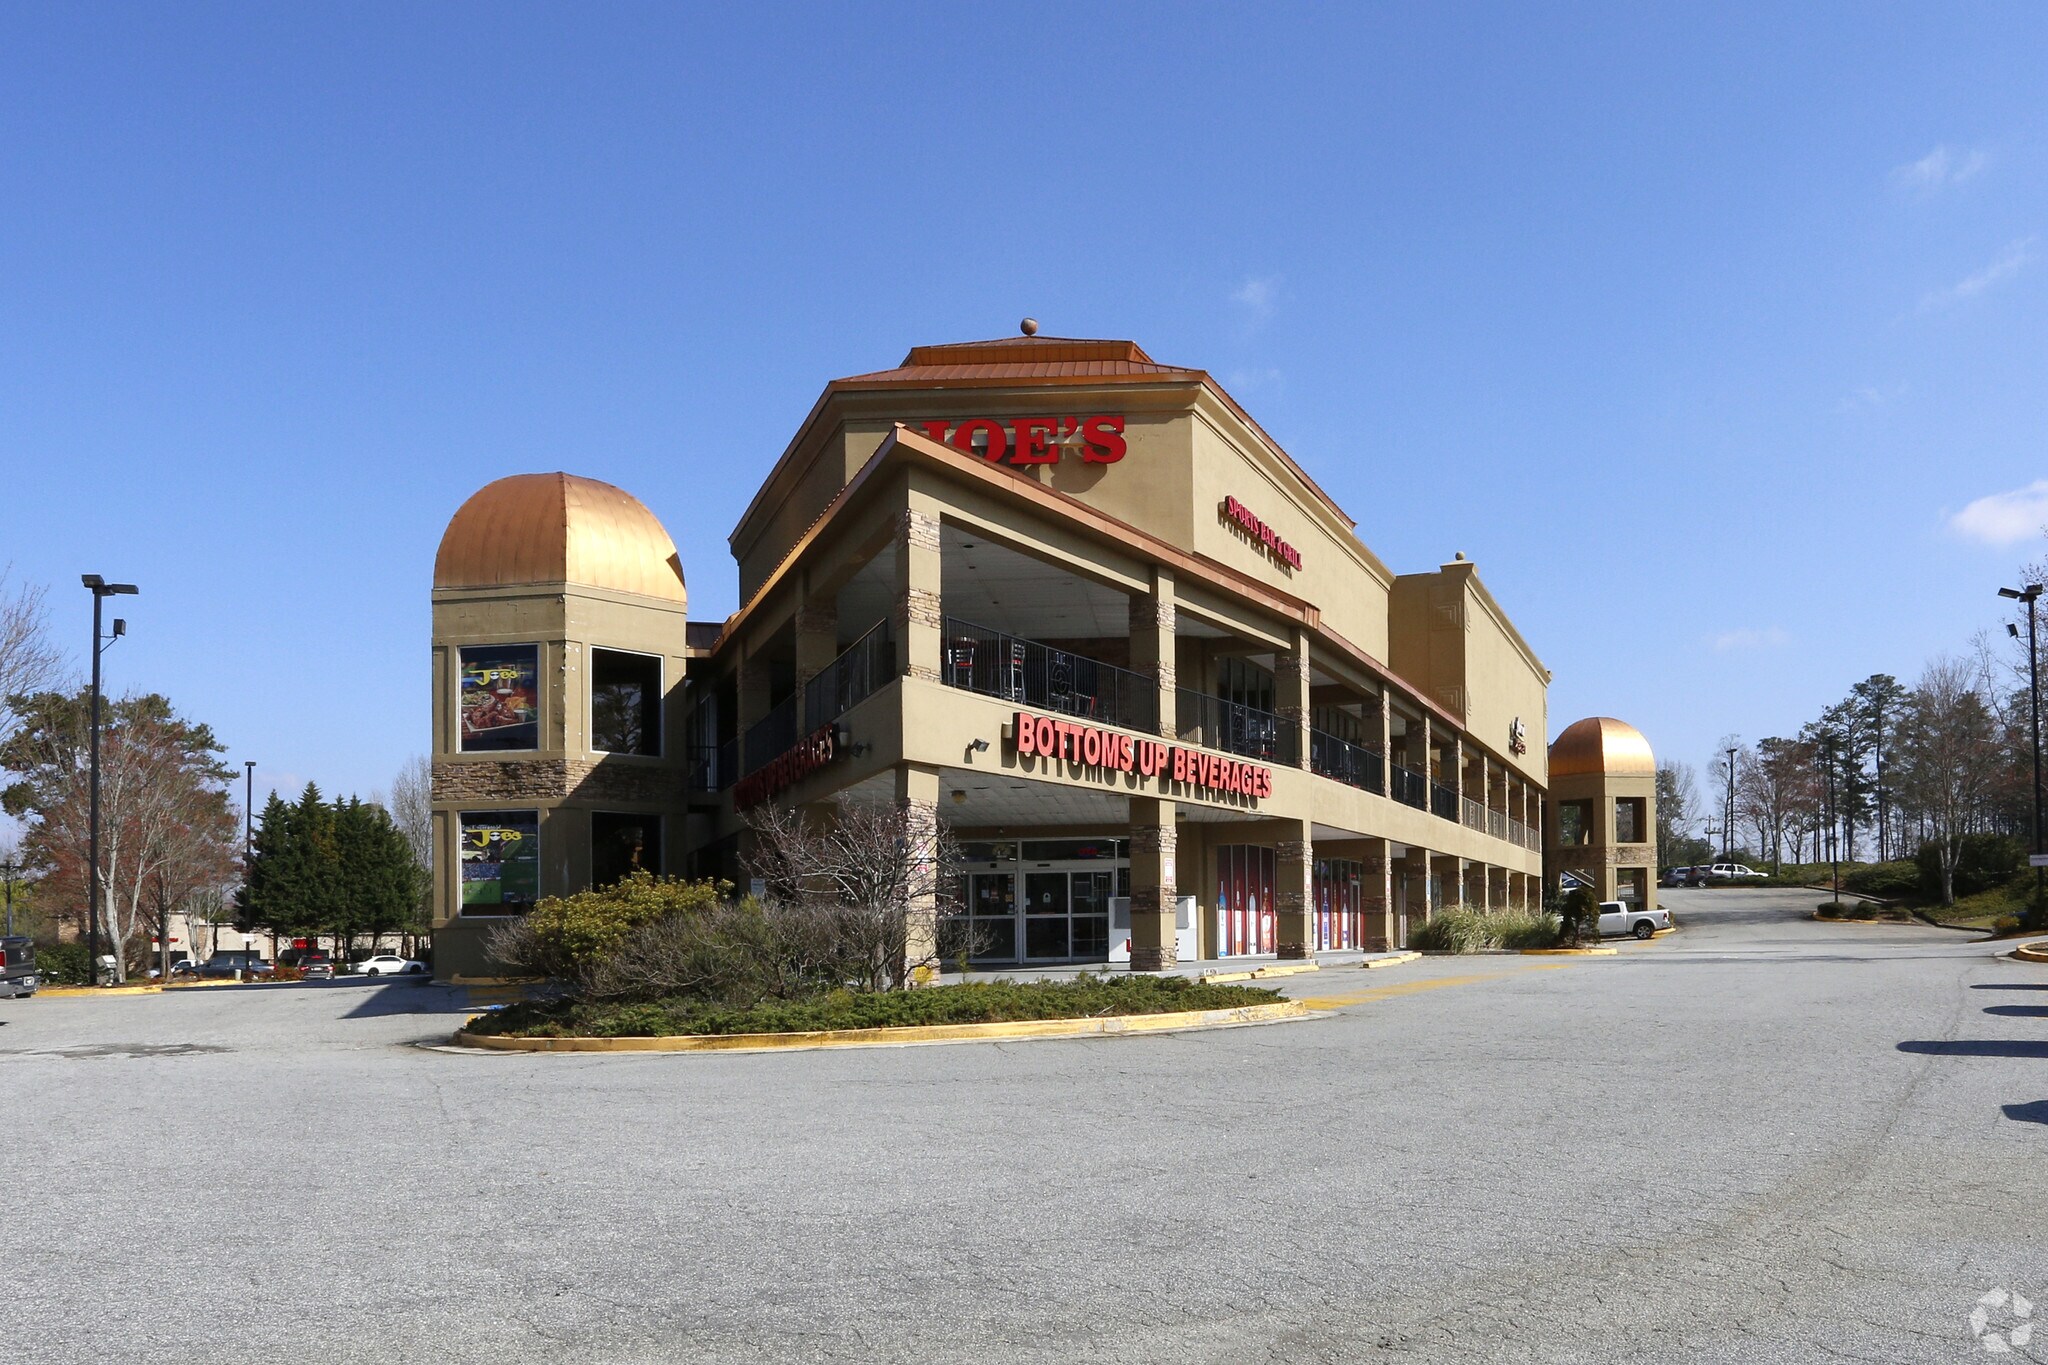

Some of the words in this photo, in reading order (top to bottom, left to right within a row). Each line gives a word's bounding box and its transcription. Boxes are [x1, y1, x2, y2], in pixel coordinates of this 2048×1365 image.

[1225, 495, 1259, 535] SPORTS
[1260, 522, 1276, 549] BAR
[1284, 541, 1302, 571] GRILL
[1017, 712, 1133, 772] BOTTOMS
[1138, 739, 1169, 777] UP
[1173, 746, 1272, 799] BEVERAGES
